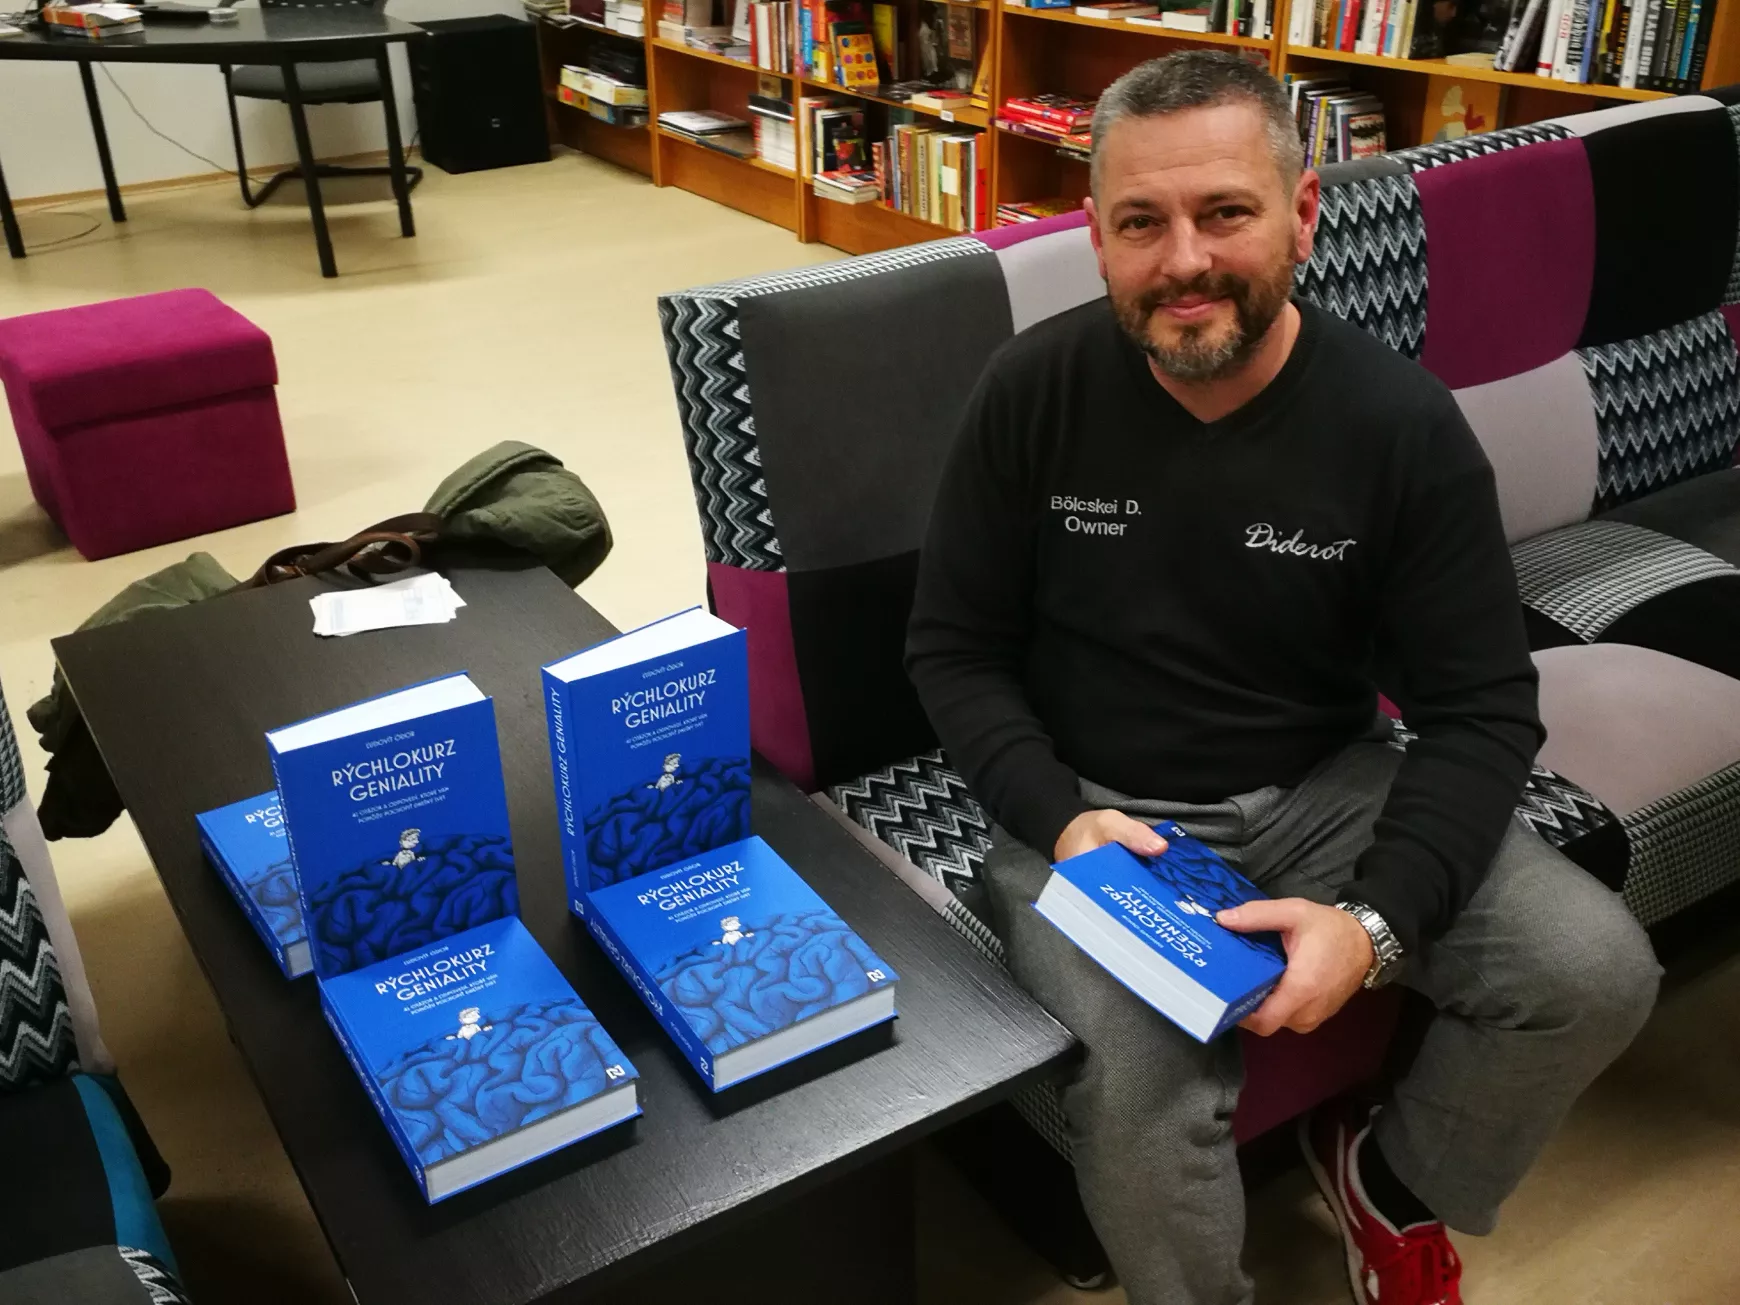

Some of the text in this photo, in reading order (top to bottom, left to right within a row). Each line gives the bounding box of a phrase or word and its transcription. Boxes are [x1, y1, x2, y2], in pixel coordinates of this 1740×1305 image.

[1638, 46, 1654, 76] BOB
[1051, 495, 1142, 515] Bölcskei D.
[1064, 516, 1128, 536] Owner
[1244, 522, 1357, 560] Diderot
[612, 669, 716, 715] RÝCHLOKURZ
[625, 690, 706, 728] GENIALITY
[550, 686, 567, 754] GENIALITY
[331, 739, 457, 787] RÝCHLOKURZ
[350, 762, 445, 802] GENIALITY
[557, 755, 576, 837] RÝCHLOKURZ
[637, 860, 745, 906] RÝCHLOKURZ
[659, 874, 740, 911] GENIALITY
[1121, 890, 1204, 954] GENIALITY
[375, 943, 496, 995] RÝCHLOKURZ
[396, 960, 487, 1001] GENIALITY
